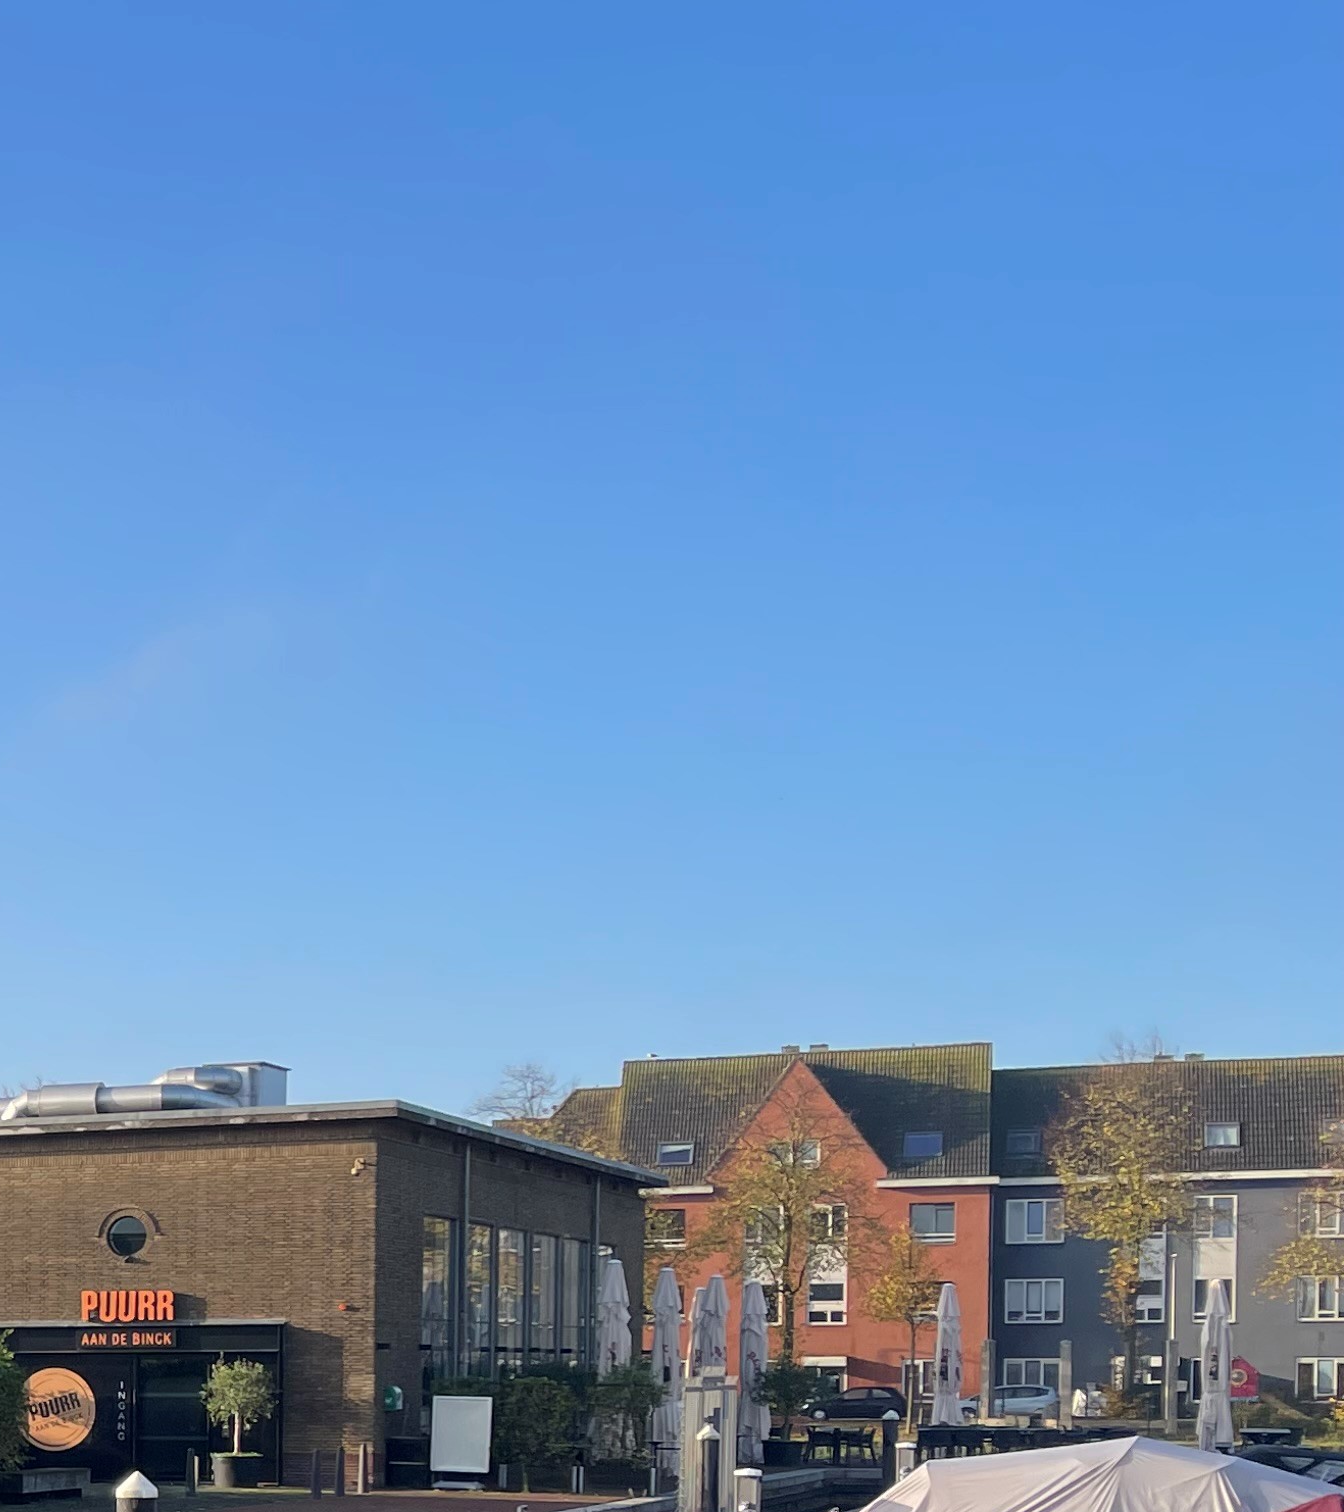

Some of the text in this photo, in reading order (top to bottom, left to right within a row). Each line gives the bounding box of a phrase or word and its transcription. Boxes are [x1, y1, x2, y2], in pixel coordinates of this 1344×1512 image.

[81, 1290, 174, 1323] PUURR
[81, 1332, 172, 1346] AAN DE BINCK
[29, 1392, 81, 1421] PUURR
[117, 1380, 126, 1441] INGANG
